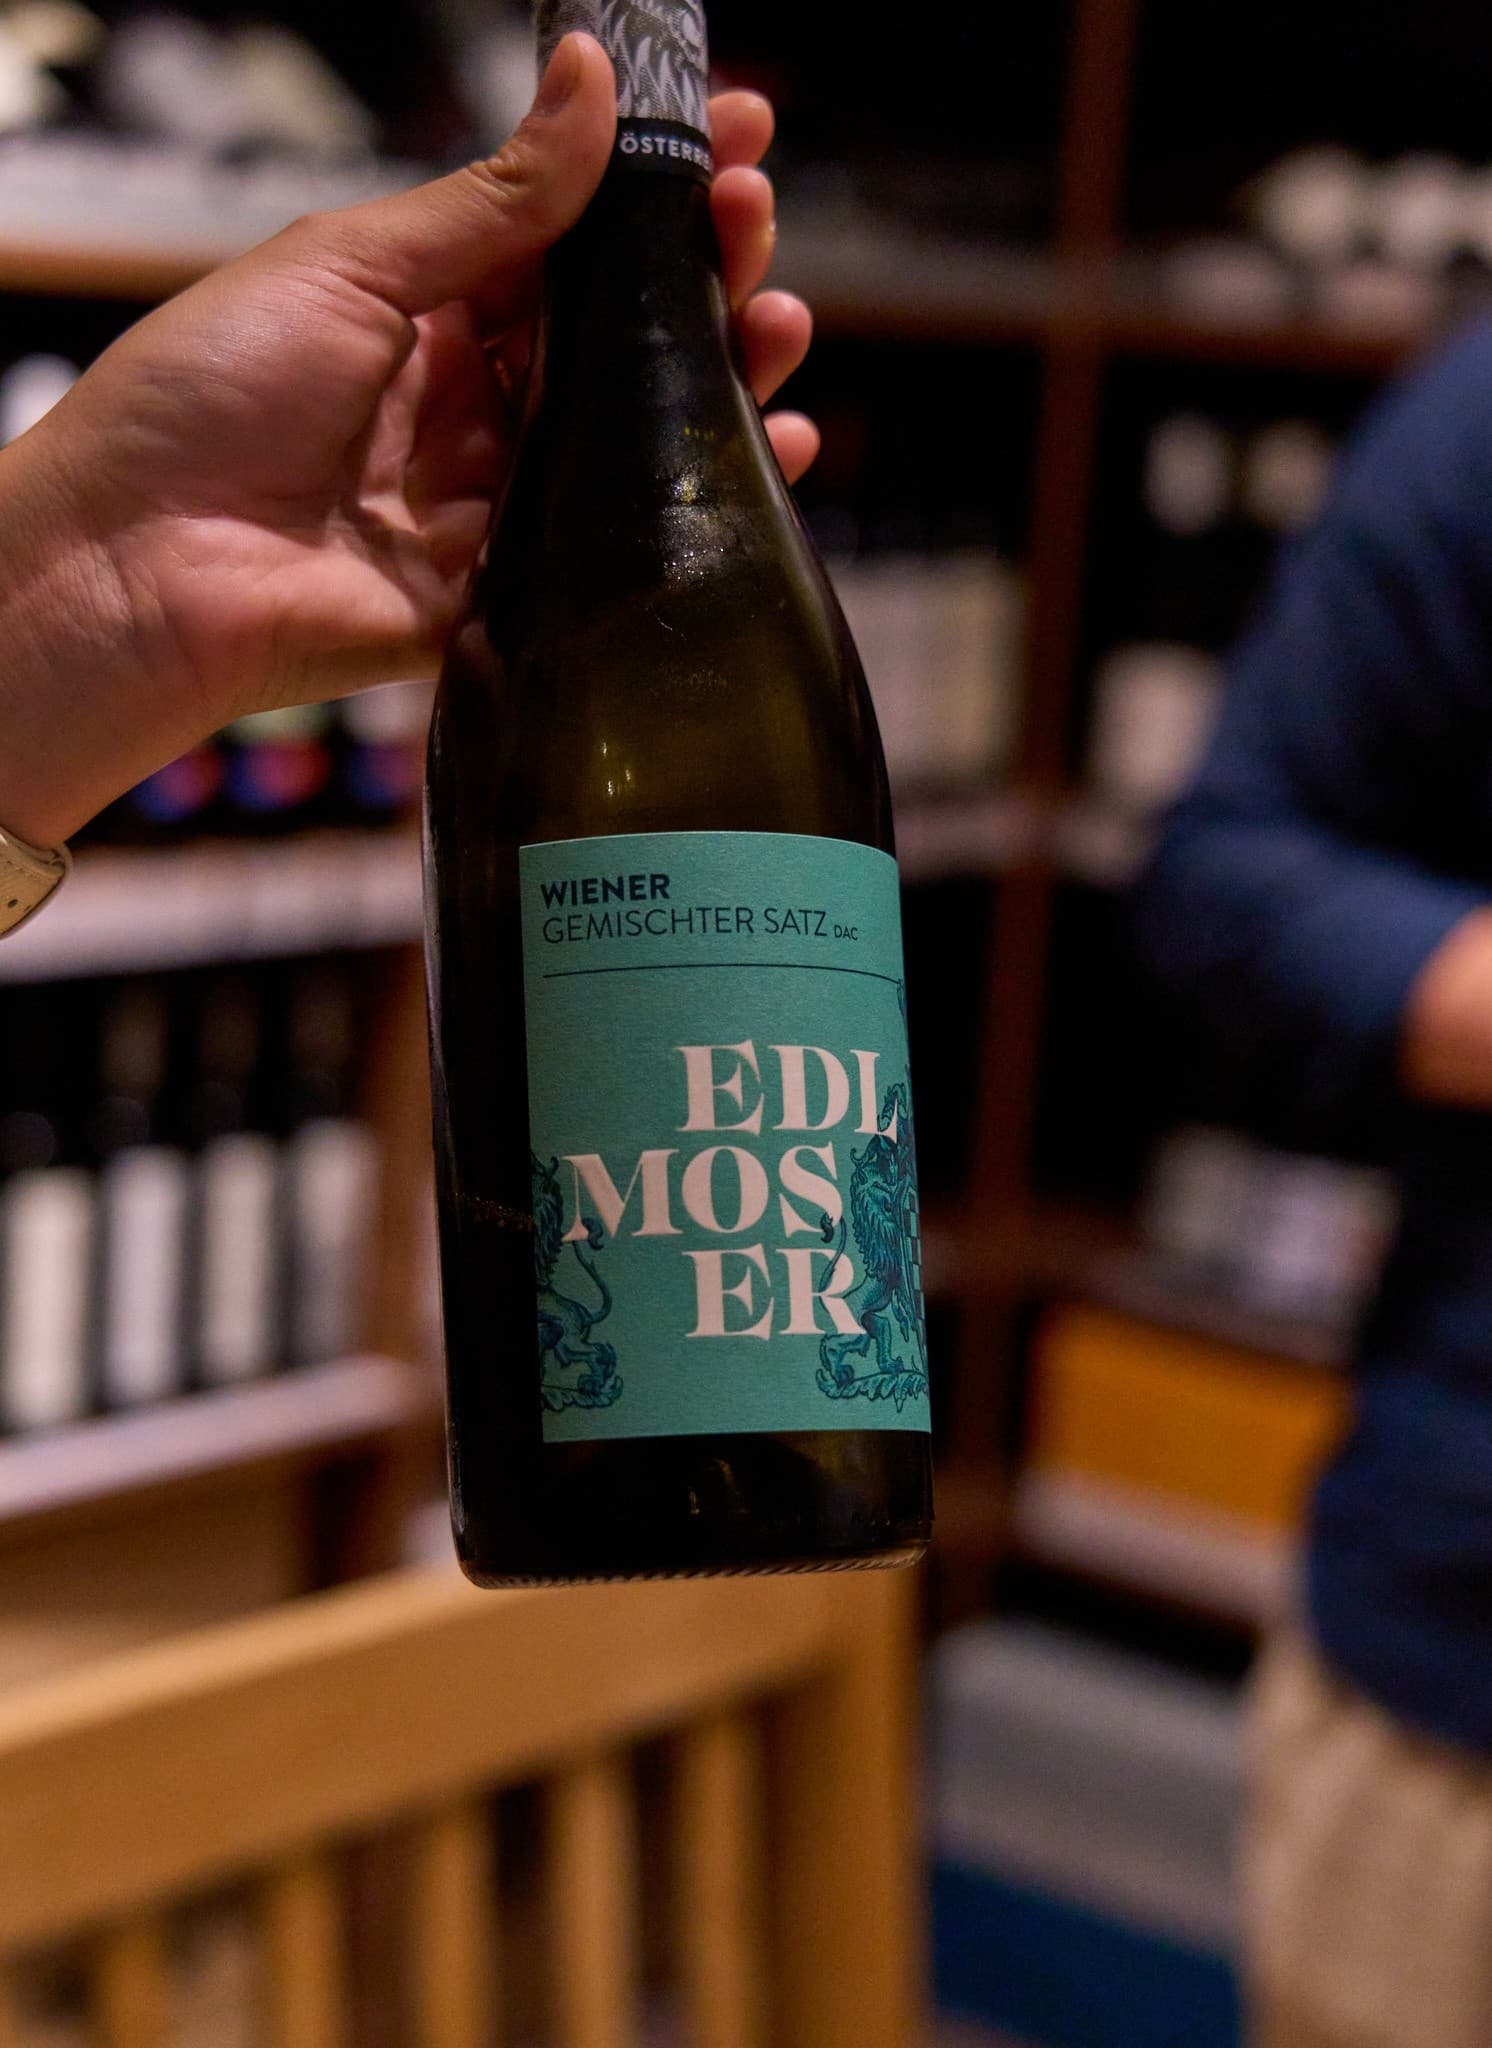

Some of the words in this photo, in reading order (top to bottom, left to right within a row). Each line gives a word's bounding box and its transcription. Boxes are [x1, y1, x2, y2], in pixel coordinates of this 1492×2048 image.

[541, 874, 670, 908] WIENER
[543, 907, 754, 944] GEMISCHTER
[764, 908, 828, 938] SATZ
[833, 924, 859, 941] DAC
[675, 1039, 899, 1144] EDL
[561, 1141, 844, 1243] MOS
[682, 1243, 867, 1341] ER
